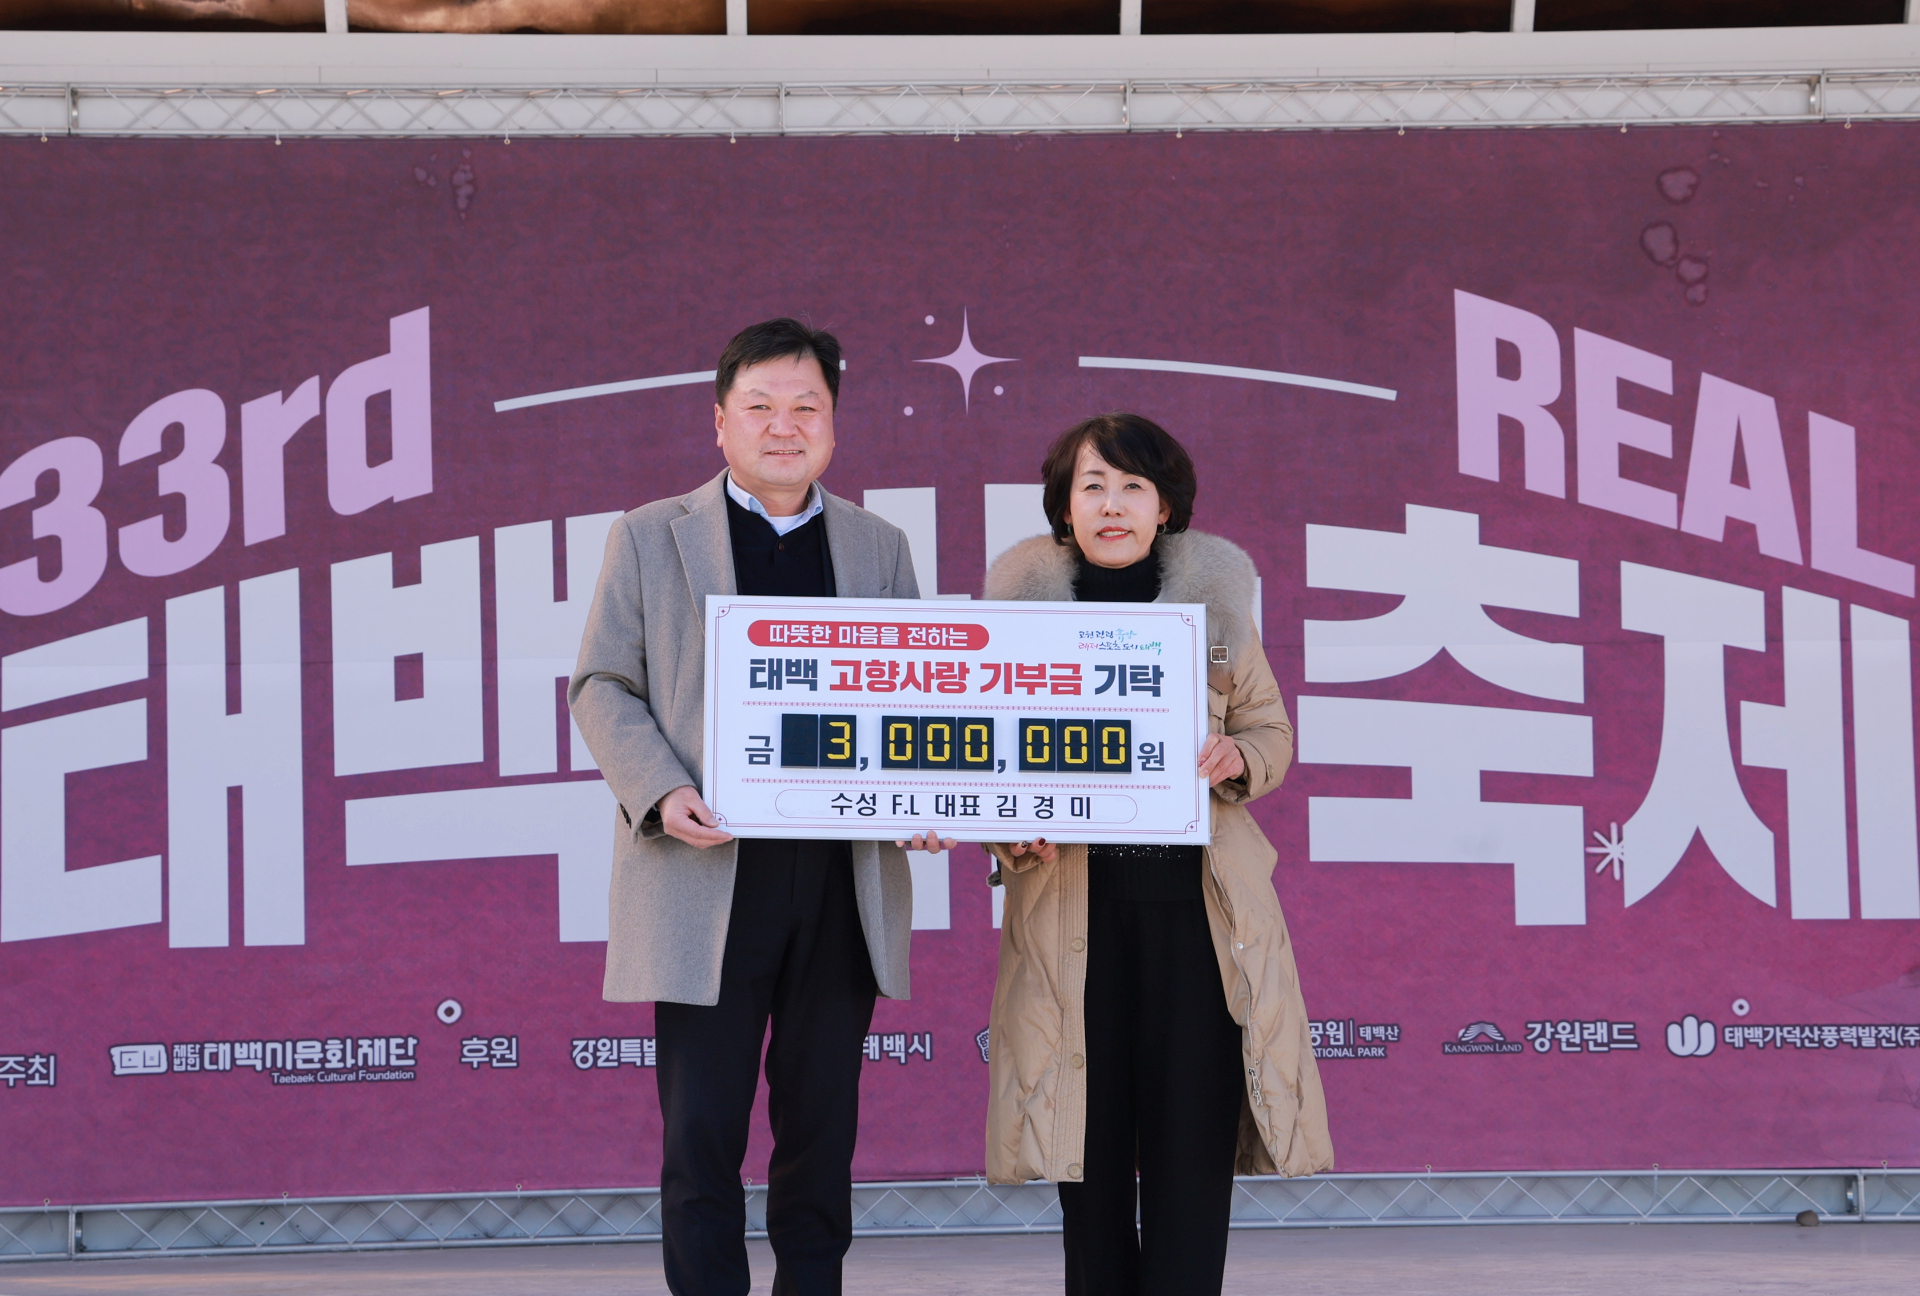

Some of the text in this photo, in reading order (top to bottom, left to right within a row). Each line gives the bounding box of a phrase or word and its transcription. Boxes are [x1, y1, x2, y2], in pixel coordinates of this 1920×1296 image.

[0, 288, 1916, 616] 33rd REAL
[769, 624, 968, 647] 따뜻한 마음을 전하는
[749, 658, 1165, 698] 태백 고향사랑 기부금 기탁
[744, 735, 775, 766] 금
[831, 792, 877, 816] 수성
[892, 794, 920, 815] F.L
[934, 794, 981, 818] 대표
[863, 1033, 931, 1064] 태백시
[1309, 1021, 1399, 1046] 공원 태백산
[1444, 1043, 1523, 1053] KANGWON LAND
[1525, 1021, 1639, 1053] 강원랜드
[203, 1037, 418, 1071] 태백시문화재단
[460, 1037, 518, 1069] 후원
[572, 1038, 657, 1069] 강원특별
[1314, 1046, 1385, 1058] ATIONAL PARK
[0, 1054, 55, 1087] 주최
[272, 1069, 415, 1084] Taebaek Cultural Foundation
